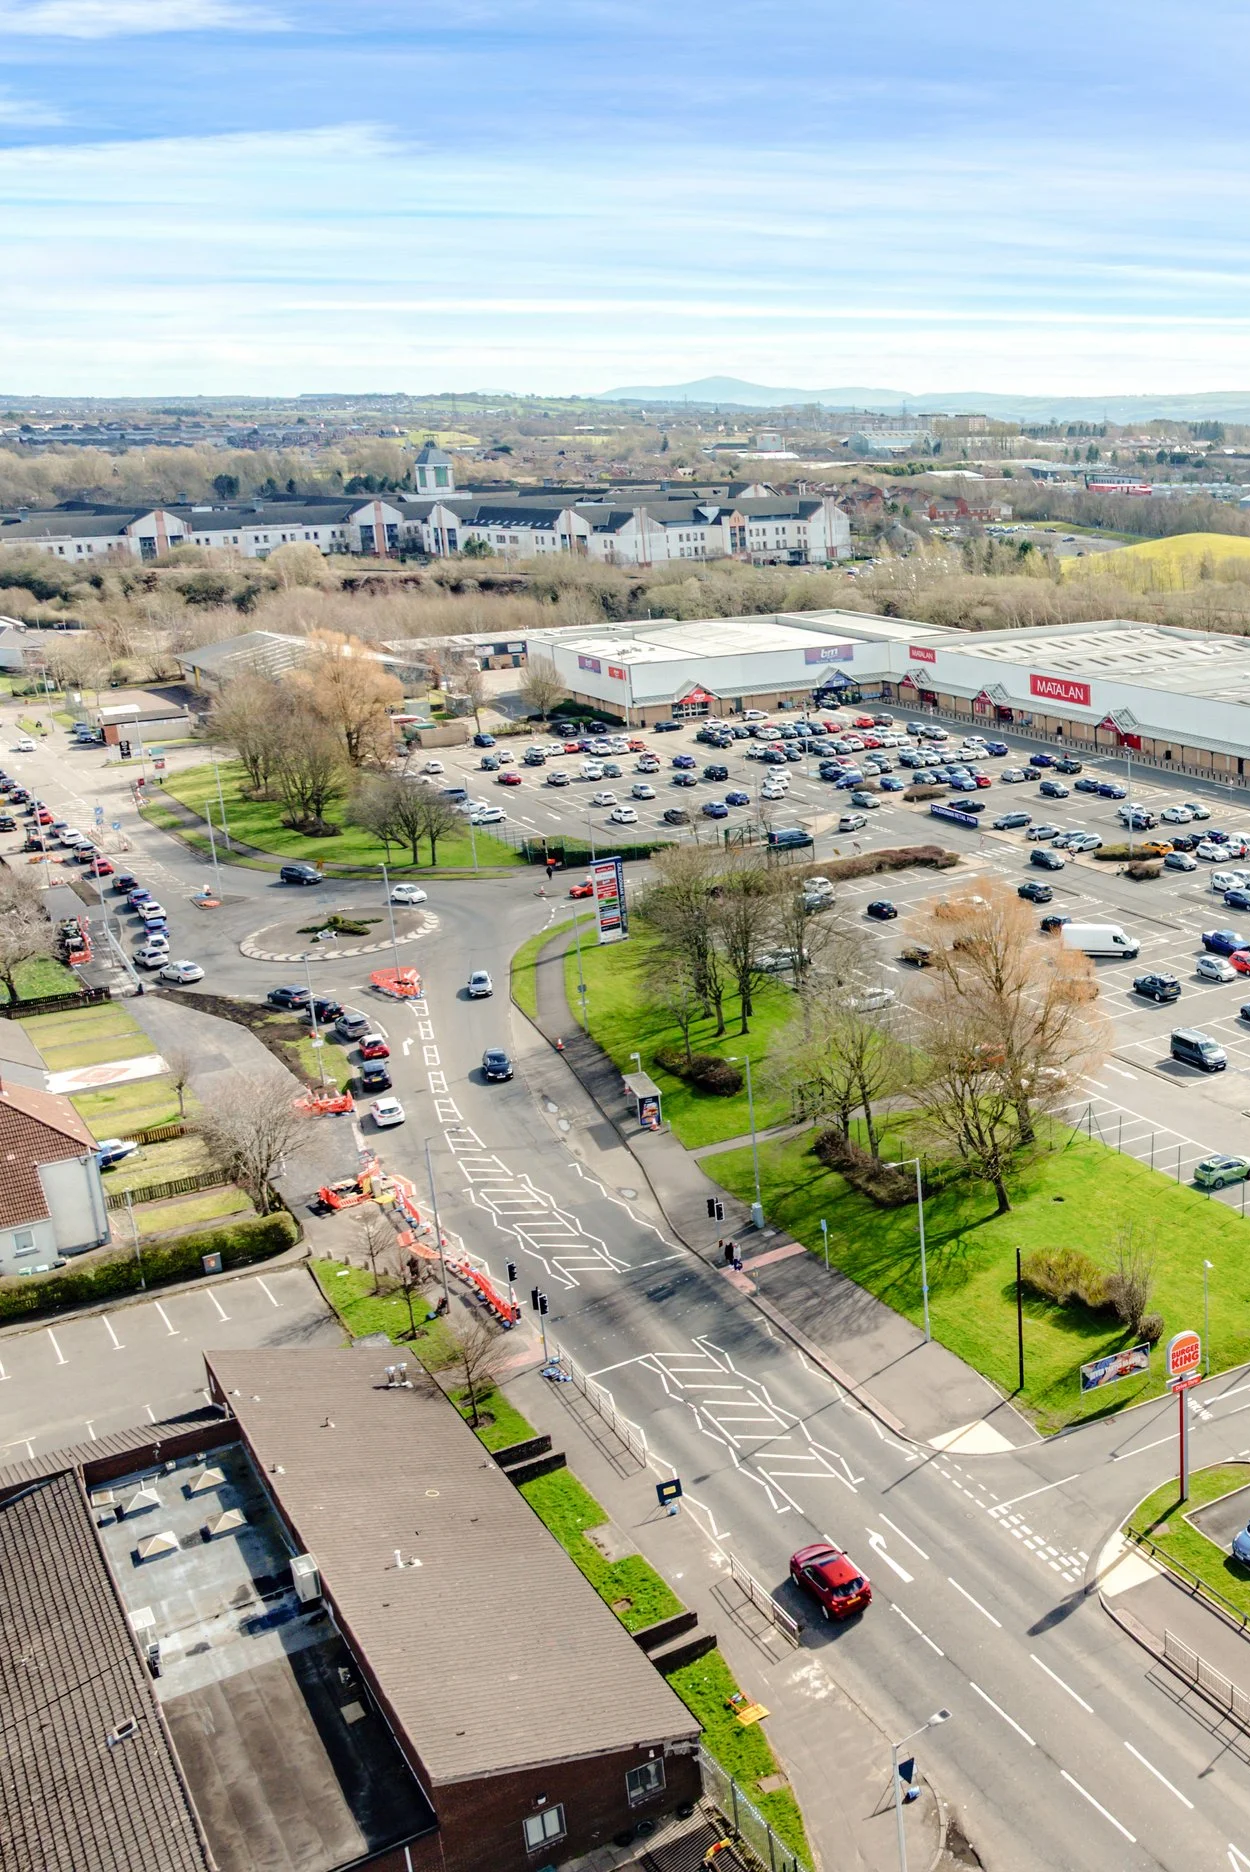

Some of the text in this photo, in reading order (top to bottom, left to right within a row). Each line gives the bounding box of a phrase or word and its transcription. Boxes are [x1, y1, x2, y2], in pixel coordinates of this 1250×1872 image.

[911, 649, 934, 660] MATALAN
[1037, 680, 1084, 700] MATALAN
[1171, 1343, 1199, 1359] BURGER
[1171, 1350, 1199, 1370] KING
